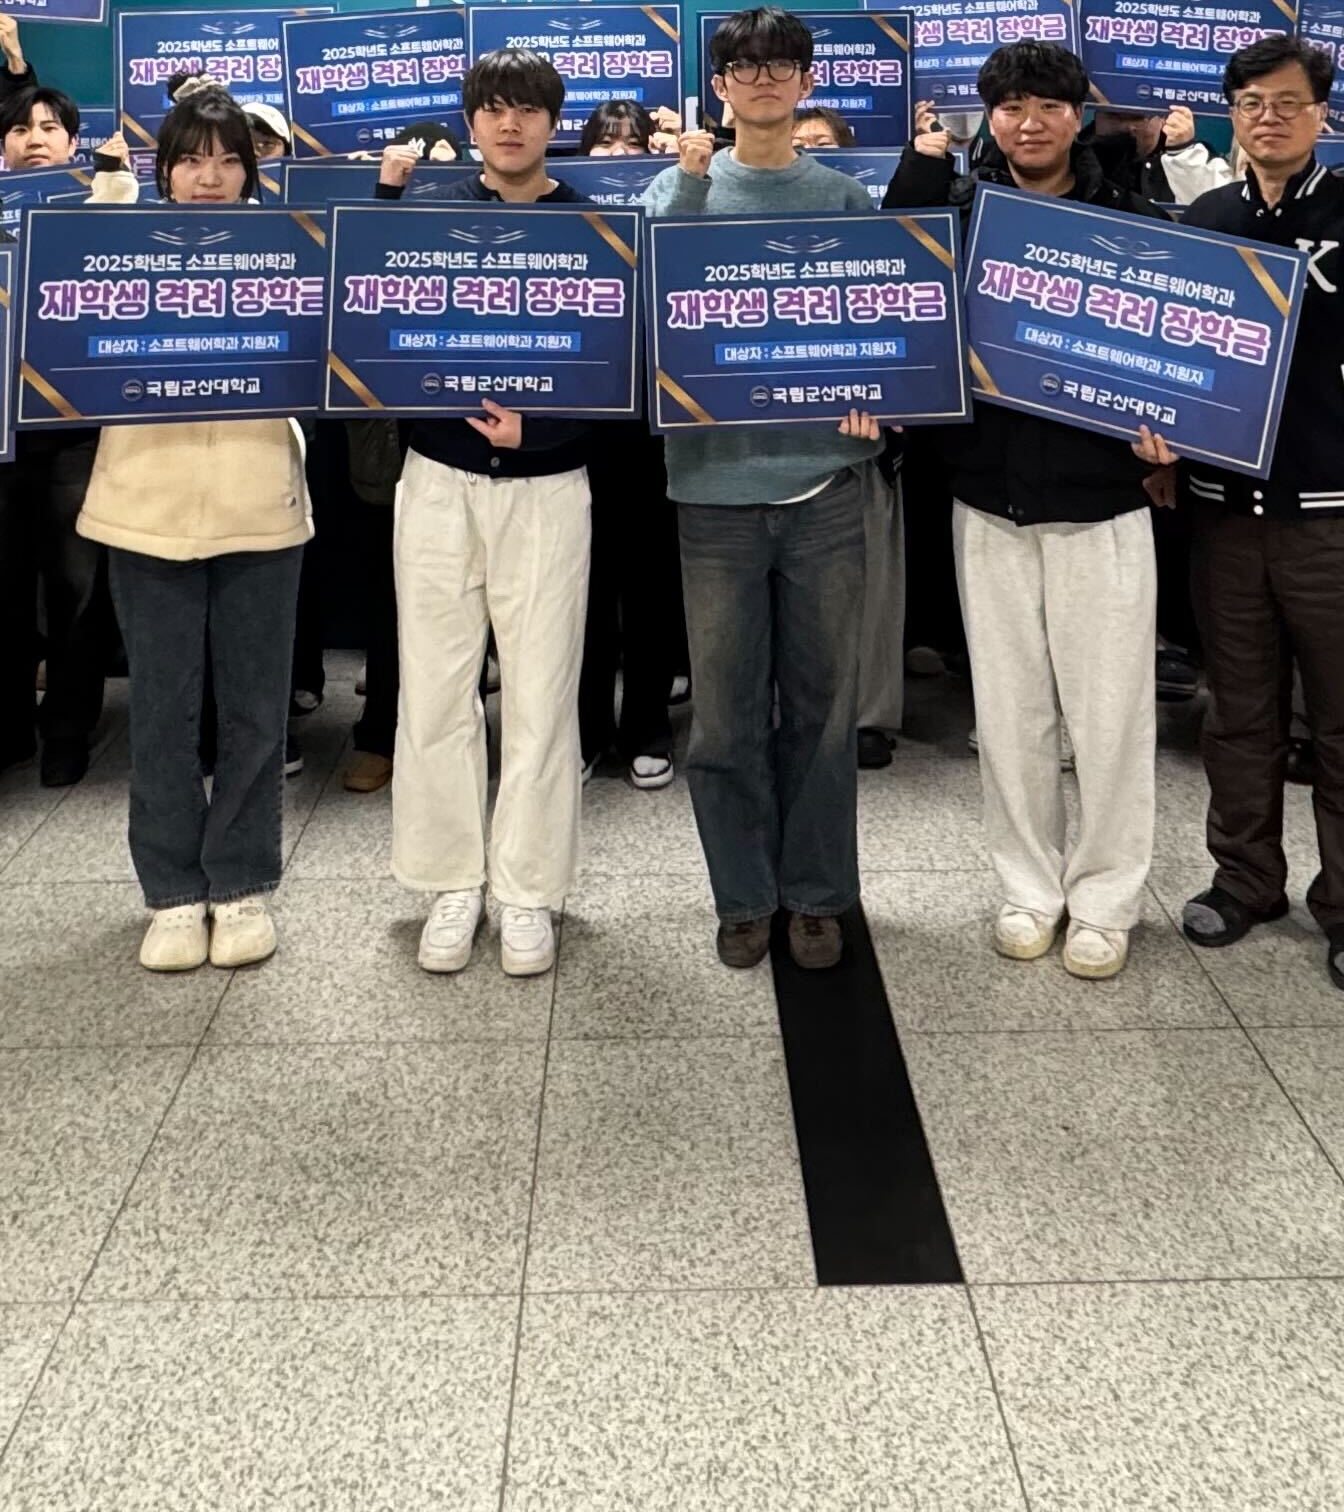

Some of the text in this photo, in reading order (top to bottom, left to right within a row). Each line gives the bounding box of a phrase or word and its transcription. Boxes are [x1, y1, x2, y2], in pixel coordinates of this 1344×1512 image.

[899, 2, 963, 17] 25학년도
[1115, 1, 1262, 24] 2025학년도 소프트웨어학과
[506, 34, 647, 49] 2025학년도 소프트웨어학과
[947, 16, 995, 45] 격려
[996, 14, 1067, 43] 장학금
[1086, 15, 1158, 47] 재학생
[1161, 21, 1209, 51] 격려
[1213, 25, 1287, 53] 장학
[157, 38, 279, 54] 2025학년도 소프트웨어
[321, 44, 388, 61] 2025학년도
[812, 43, 877, 56] 프트웨어학과
[296, 62, 369, 94] 재학생
[372, 56, 420, 87] 격려
[423, 54, 468, 83] 장학
[554, 51, 601, 79] 격려
[604, 50, 673, 78] 장학금
[833, 59, 903, 86] 장학금
[83, 253, 297, 273] 2025학년도 소프트웨어학과
[384, 250, 589, 272] 2025학년도 소프트웨어학과
[704, 257, 907, 283] 2025학년도 소프트웨어학과
[1294, 237, 1340, 293] K
[1023, 242, 1237, 308] 2025학년도 소프트웨어학과
[38, 278, 150, 321] 재학생
[155, 278, 227, 320] 격려
[344, 274, 626, 318] 재학생 격려 장학금
[667, 281, 947, 329] 재학생 격려 장학금
[977, 258, 1272, 366] 재학생 격려 장학금
[98, 338, 139, 355] 대상자
[148, 338, 240, 353] 소프트웨어학과
[241, 336, 280, 351] 지원자
[399, 334, 438, 349] 대상자
[445, 334, 533, 349] 소프트웨어학과
[534, 335, 573, 350] 지원자
[724, 346, 763, 362] 대상자
[771, 343, 858, 360] 소프트웨어학과
[859, 341, 897, 357] 지원자
[1024, 326, 1064, 350] 대상자
[1070, 340, 1162, 375] 소프트웨어학과
[1163, 361, 1206, 387] 지원자
[145, 377, 261, 396] 국립군산대학교
[443, 375, 554, 393] 국립군산대학교
[772, 383, 883, 403] 국립군산대학교
[1063, 379, 1177, 426] 국립군산대학교
